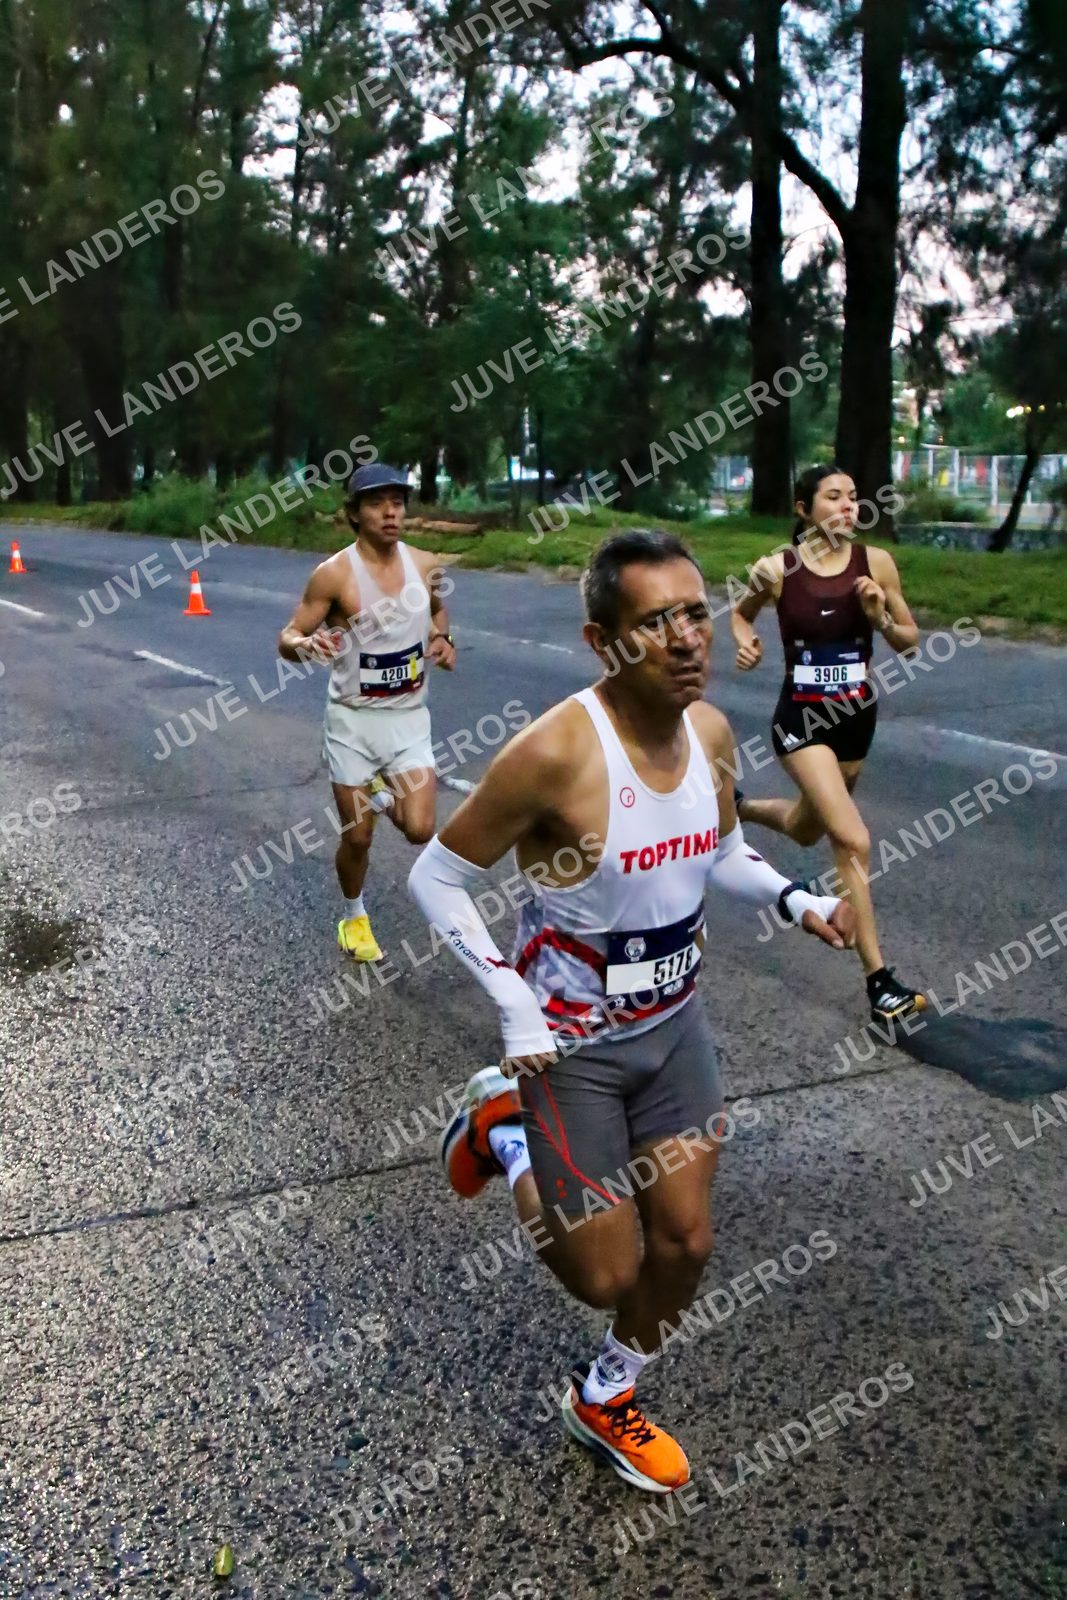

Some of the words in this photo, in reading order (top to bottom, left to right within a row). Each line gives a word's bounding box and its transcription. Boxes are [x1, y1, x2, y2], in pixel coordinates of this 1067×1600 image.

[381, 666, 408, 682] 4201
[814, 667, 848, 683] 3906
[619, 826, 718, 875] TOPTIME
